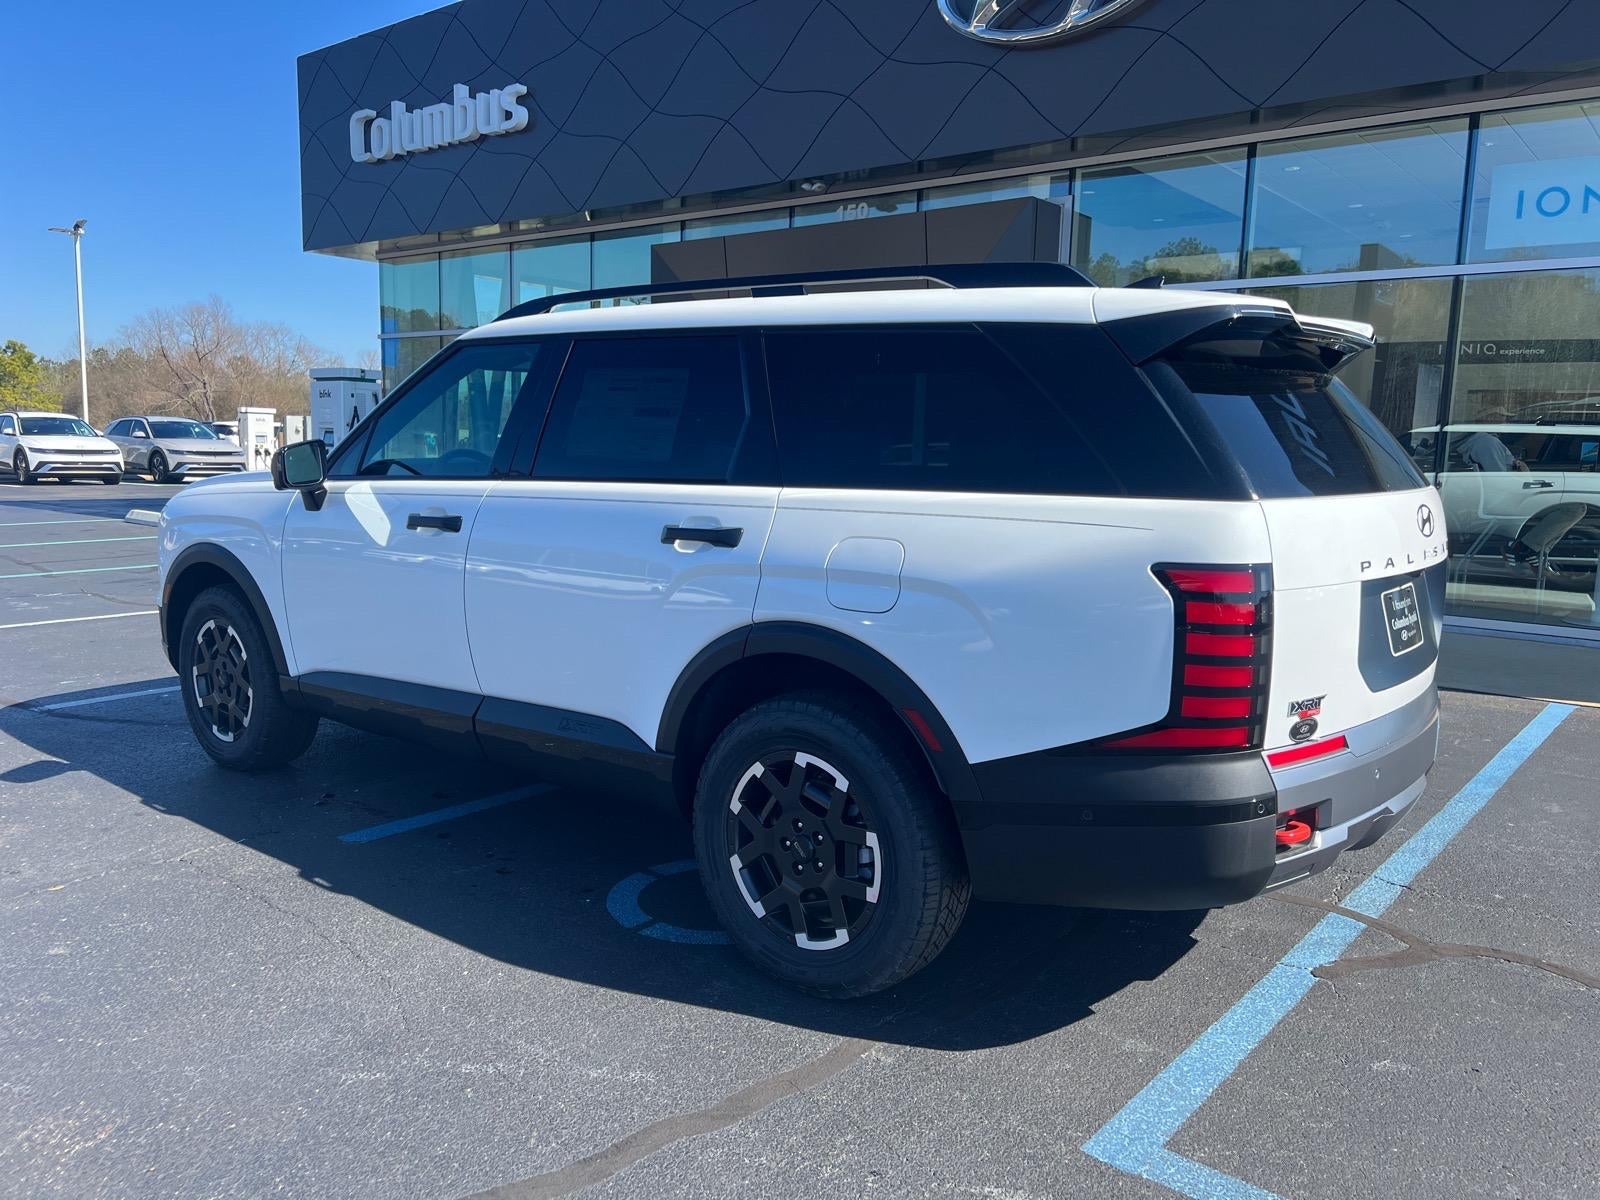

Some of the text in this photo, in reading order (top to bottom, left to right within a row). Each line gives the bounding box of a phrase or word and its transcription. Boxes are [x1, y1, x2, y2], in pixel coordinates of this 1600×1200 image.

[350, 83, 529, 163] Columbus
[836, 202, 869, 221] 150
[1438, 343, 1545, 356] INIQ experience
